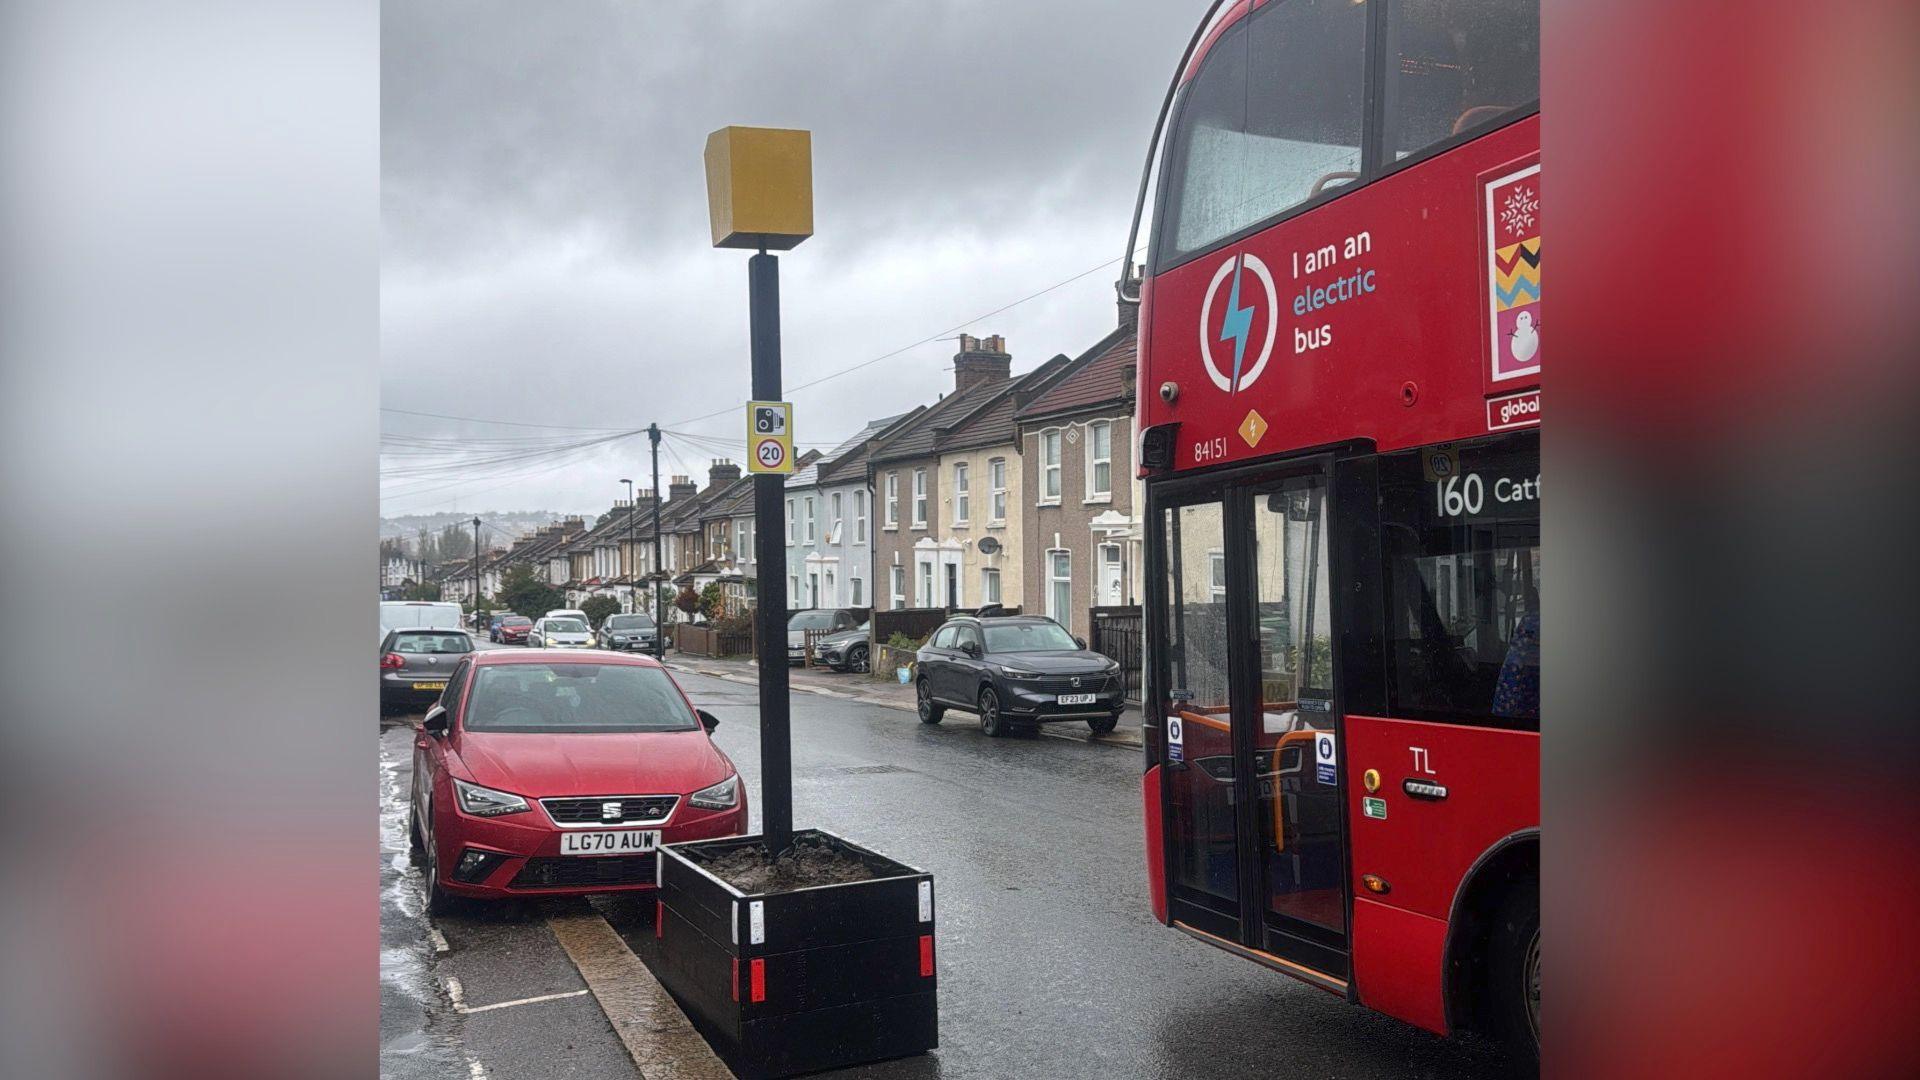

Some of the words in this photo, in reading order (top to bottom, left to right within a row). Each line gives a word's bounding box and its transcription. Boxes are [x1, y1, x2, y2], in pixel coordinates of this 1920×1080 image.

[1292, 252, 1298, 279] I
[1304, 244, 1336, 274] am
[1344, 231, 1371, 259] an
[1293, 267, 1376, 315] electric
[1294, 324, 1332, 354] bus
[1500, 395, 1540, 423] global
[761, 446, 780, 460] 20
[1194, 437, 1227, 462] 84151
[1436, 473, 1484, 517] 160
[1409, 746, 1436, 775] TL
[568, 833, 615, 851] LG70
[621, 832, 654, 849] AUW
